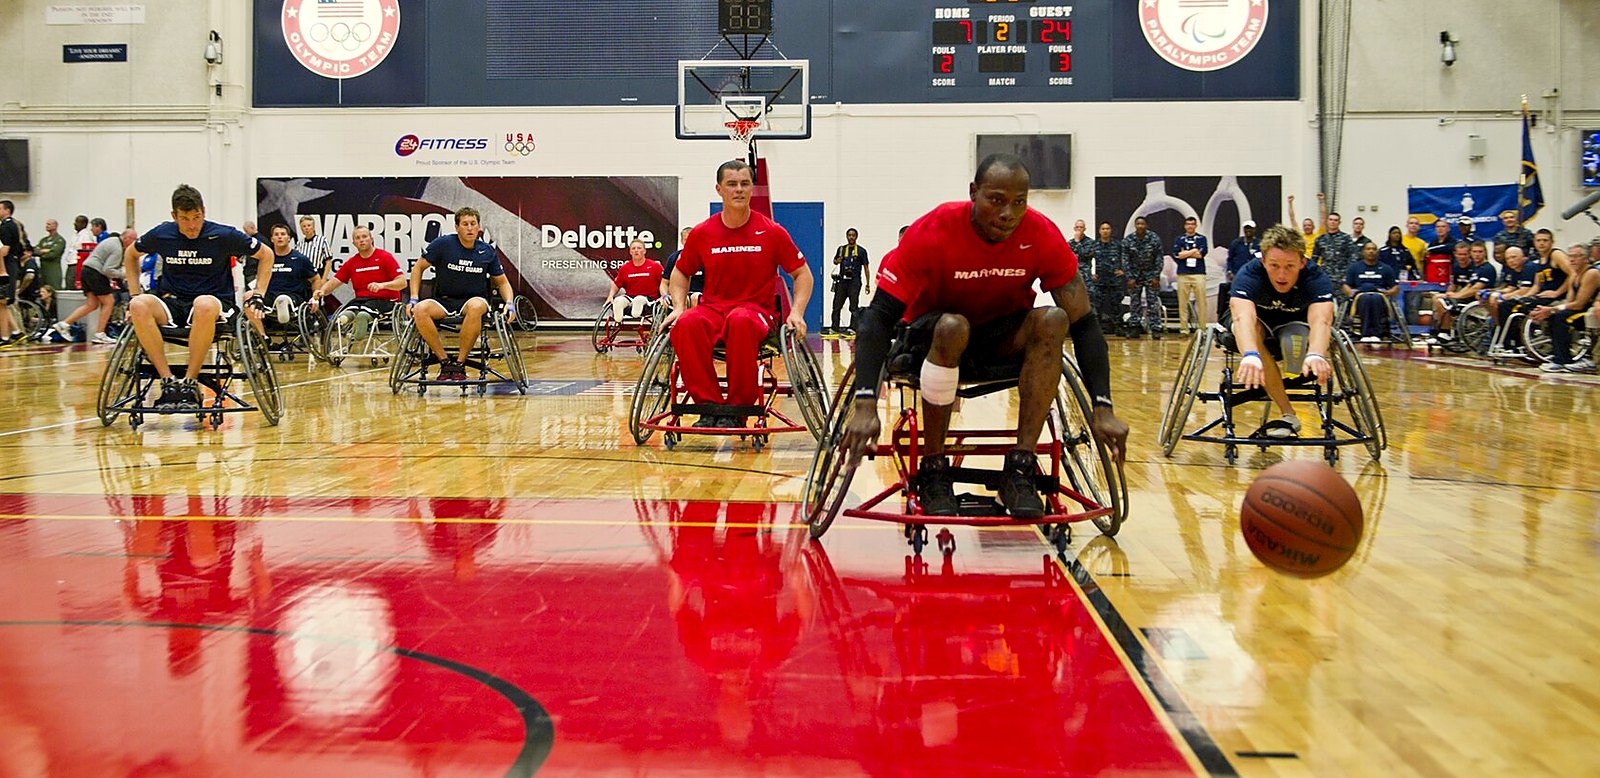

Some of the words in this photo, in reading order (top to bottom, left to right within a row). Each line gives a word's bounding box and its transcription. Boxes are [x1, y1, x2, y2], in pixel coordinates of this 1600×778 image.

[935, 8, 970, 19] HOME
[1029, 6, 1073, 17] GUEST
[988, 15, 1015, 23] PERIOD
[959, 20, 972, 43] 7
[996, 23, 1009, 41] 2
[1040, 20, 1071, 43] 24
[1147, 18, 1228, 65] PARALYMPIC
[1230, 18, 1261, 53] TEAM
[290, 32, 350, 73] OLYMPIC
[359, 32, 392, 66] TEAM
[932, 46, 956, 55] FOULS
[1049, 45, 1073, 53] FOULS
[940, 55, 954, 73] 2
[1059, 53, 1071, 72] 3
[932, 78, 956, 86] SCORE
[988, 78, 1016, 86] MATCH
[1049, 77, 1073, 86] SCORE
[400, 138, 418, 150] 24
[419, 139, 488, 150] FITNESS
[294, 213, 456, 254] WARRIO
[711, 245, 762, 254] MARINES
[447, 262, 465, 272] COAST
[465, 266, 483, 274] GUARD
[459, 259, 473, 267] NAVY
[541, 259, 608, 269] PRESENTING
[954, 268, 1026, 280] MARINES
[1246, 518, 1320, 566] MIKASA
